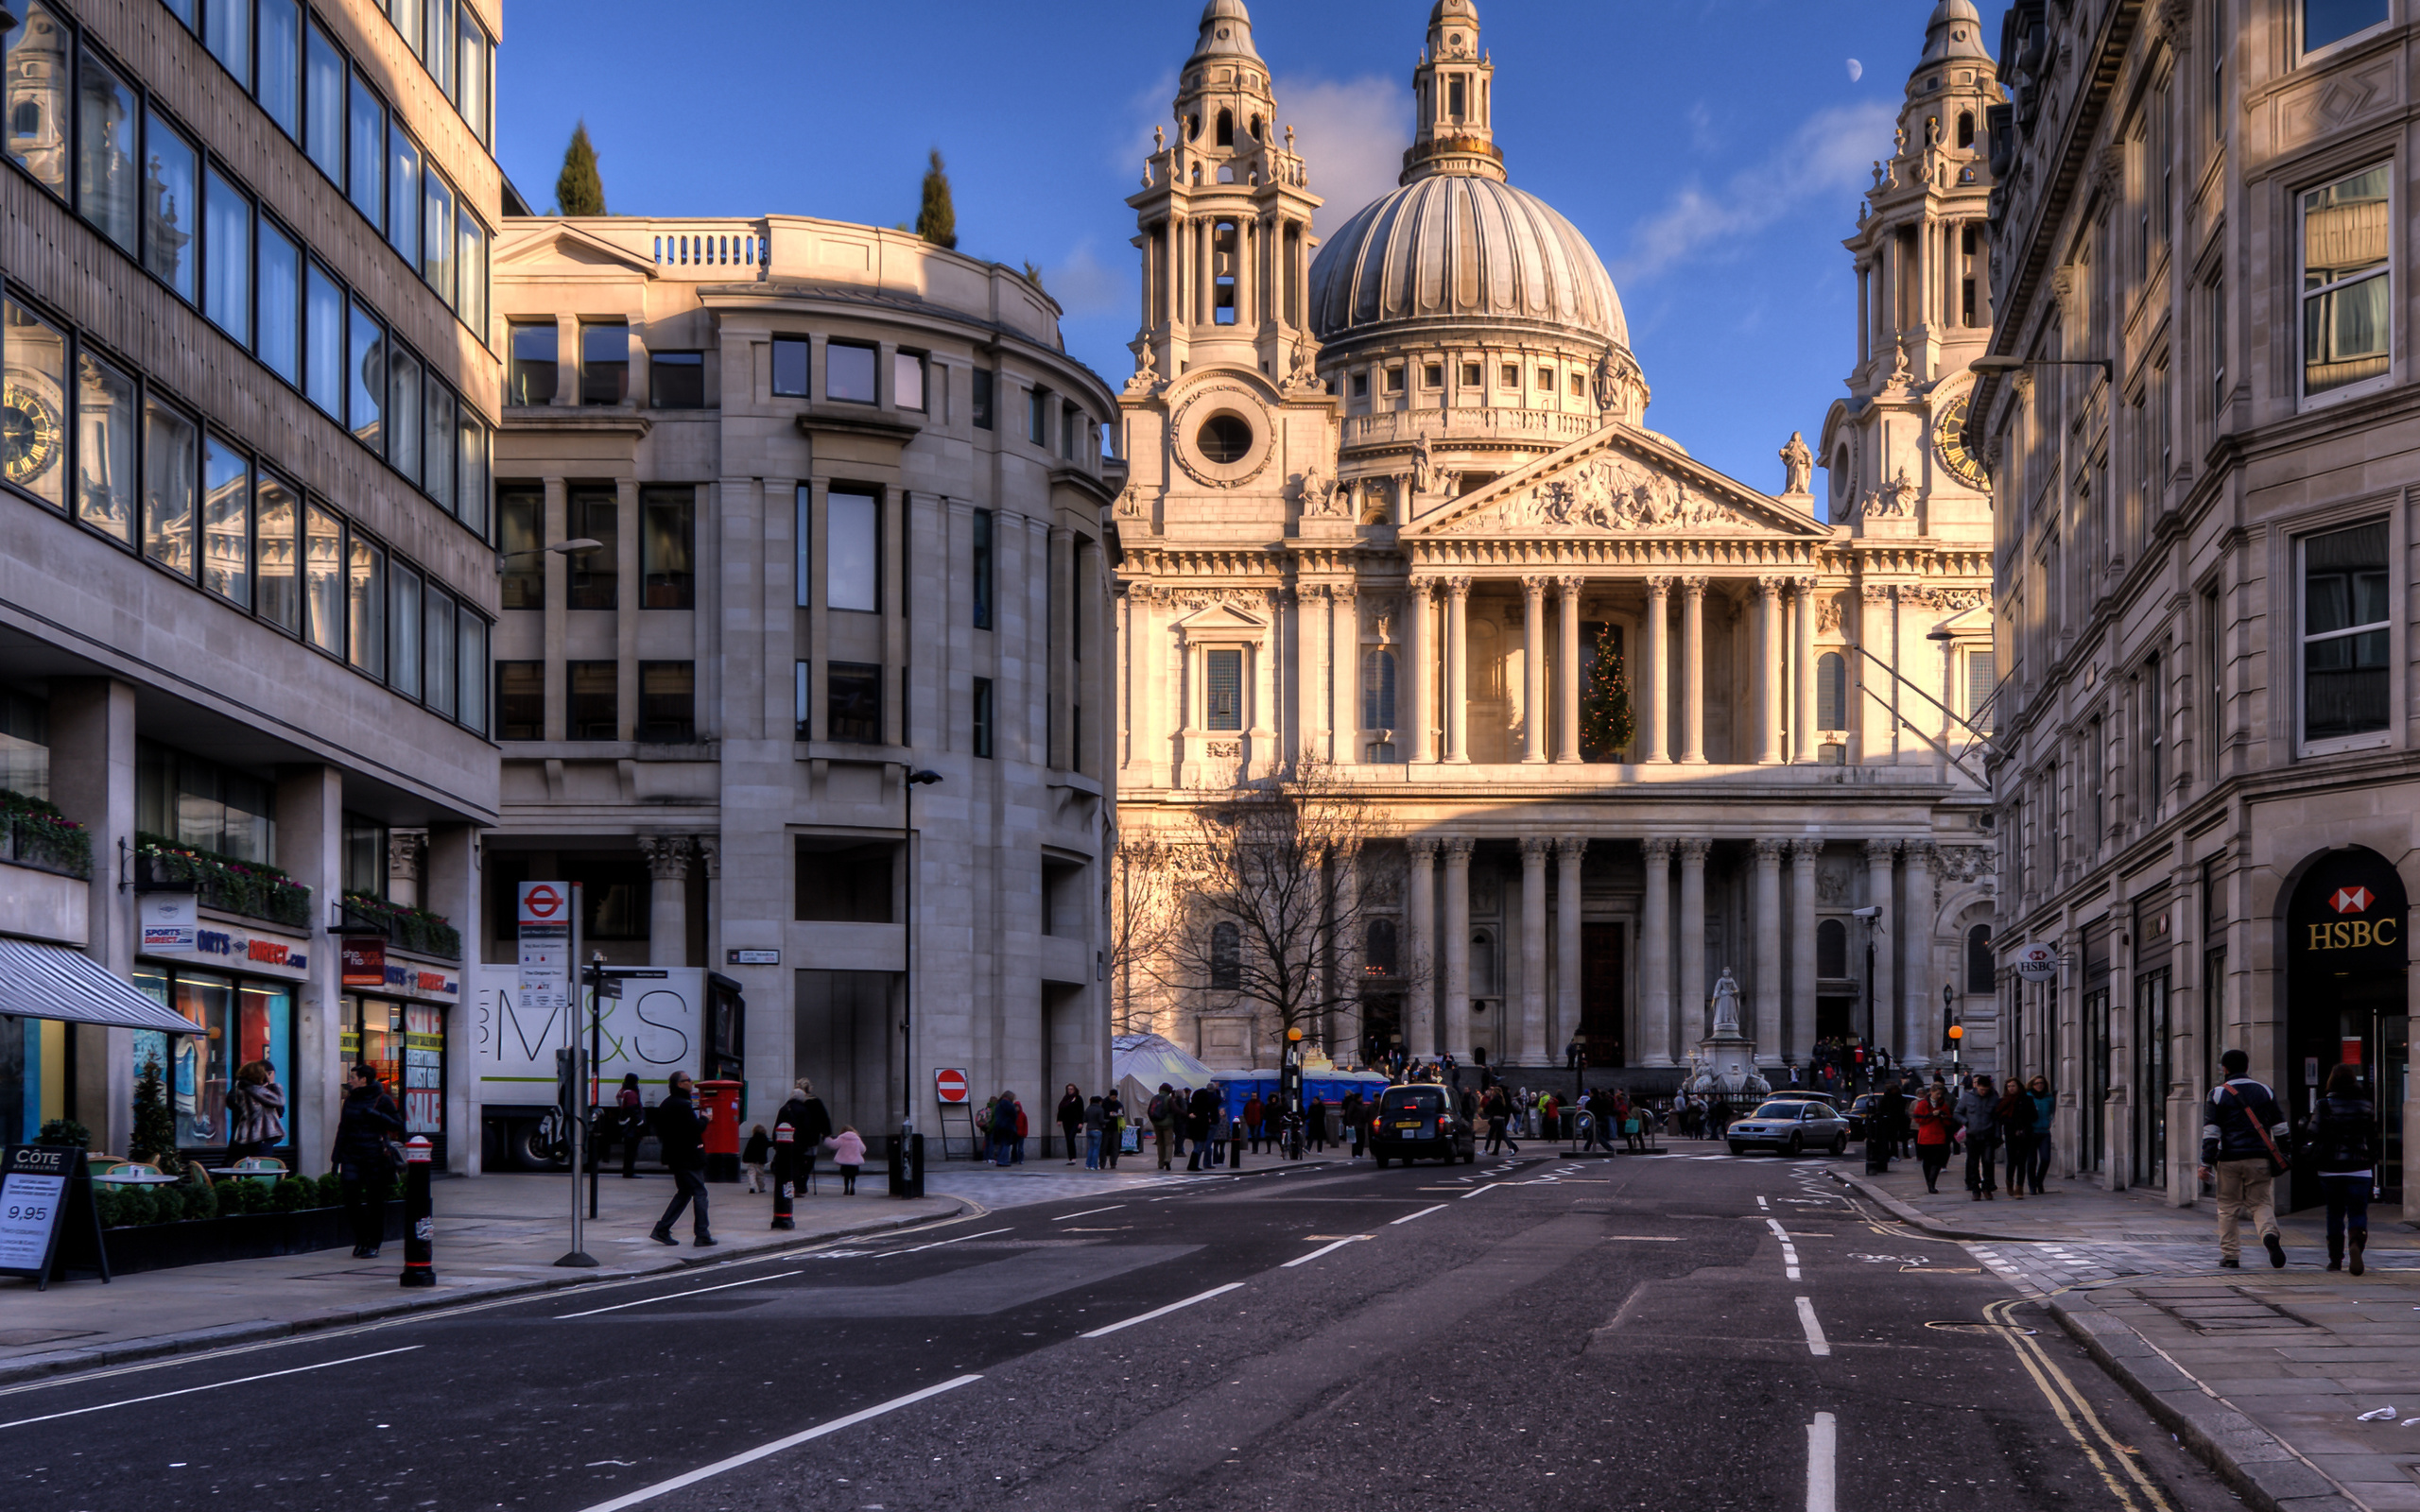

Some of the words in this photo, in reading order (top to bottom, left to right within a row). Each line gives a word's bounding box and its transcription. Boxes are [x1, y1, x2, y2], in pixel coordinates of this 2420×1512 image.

[145, 928, 181, 936] SPORTS
[2308, 918, 2397, 951] HSBC
[342, 950, 361, 958] she
[351, 955, 364, 966] he
[2020, 961, 2056, 971] HSBC
[497, 989, 688, 1064] M&S
[406, 1092, 441, 1132] SALE
[15, 1148, 62, 1164] CÔTE
